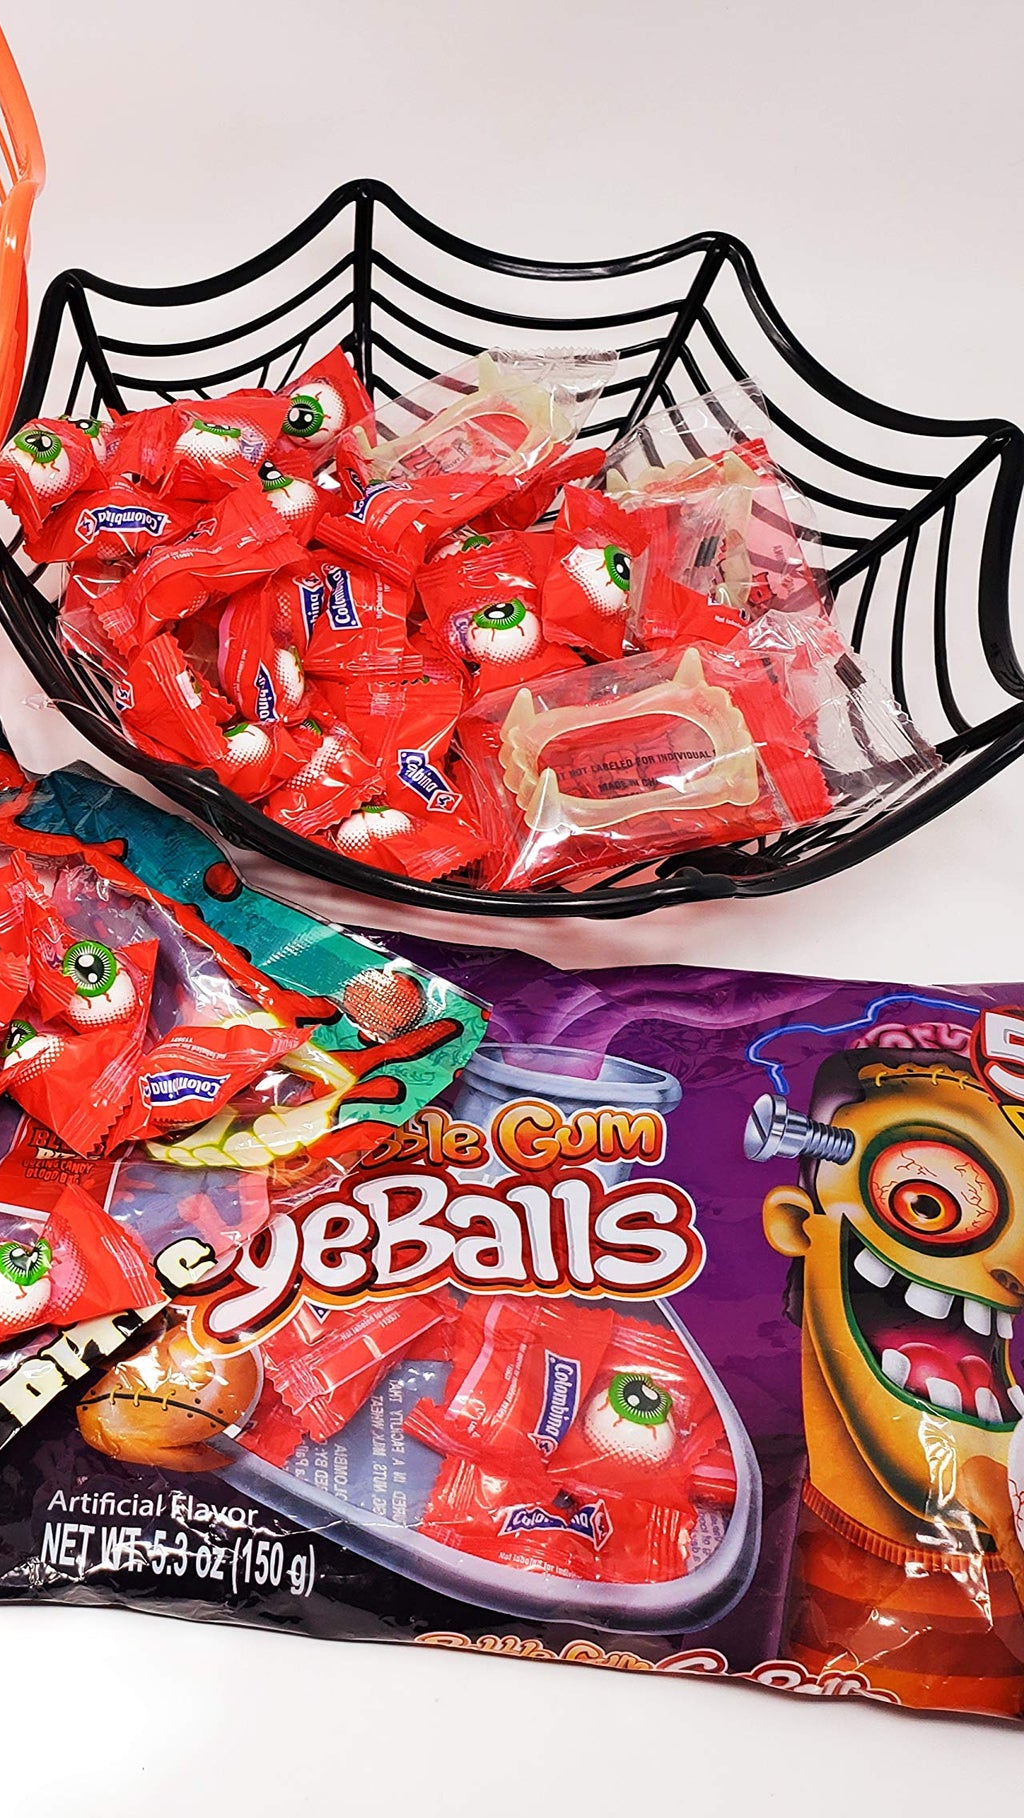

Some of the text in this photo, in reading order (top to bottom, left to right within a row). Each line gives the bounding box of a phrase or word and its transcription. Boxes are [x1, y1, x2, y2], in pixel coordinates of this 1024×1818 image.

[591, 758, 634, 775] LABELED
[635, 754, 657, 767] FOR
[657, 749, 712, 764] INDIVIDUAL
[150, 1076, 221, 1099] Colombina
[492, 1098, 664, 1171] Gum
[25, 1167, 59, 1181] BLOOD
[60, 1160, 93, 1174] CANDY
[198, 1170, 686, 1340] yeBalls
[544, 1362, 575, 1438] Colombina
[47, 1489, 260, 1530] Artificial Flavor
[40, 1522, 316, 1598] NET WT. 5.3 oz (150 g)
